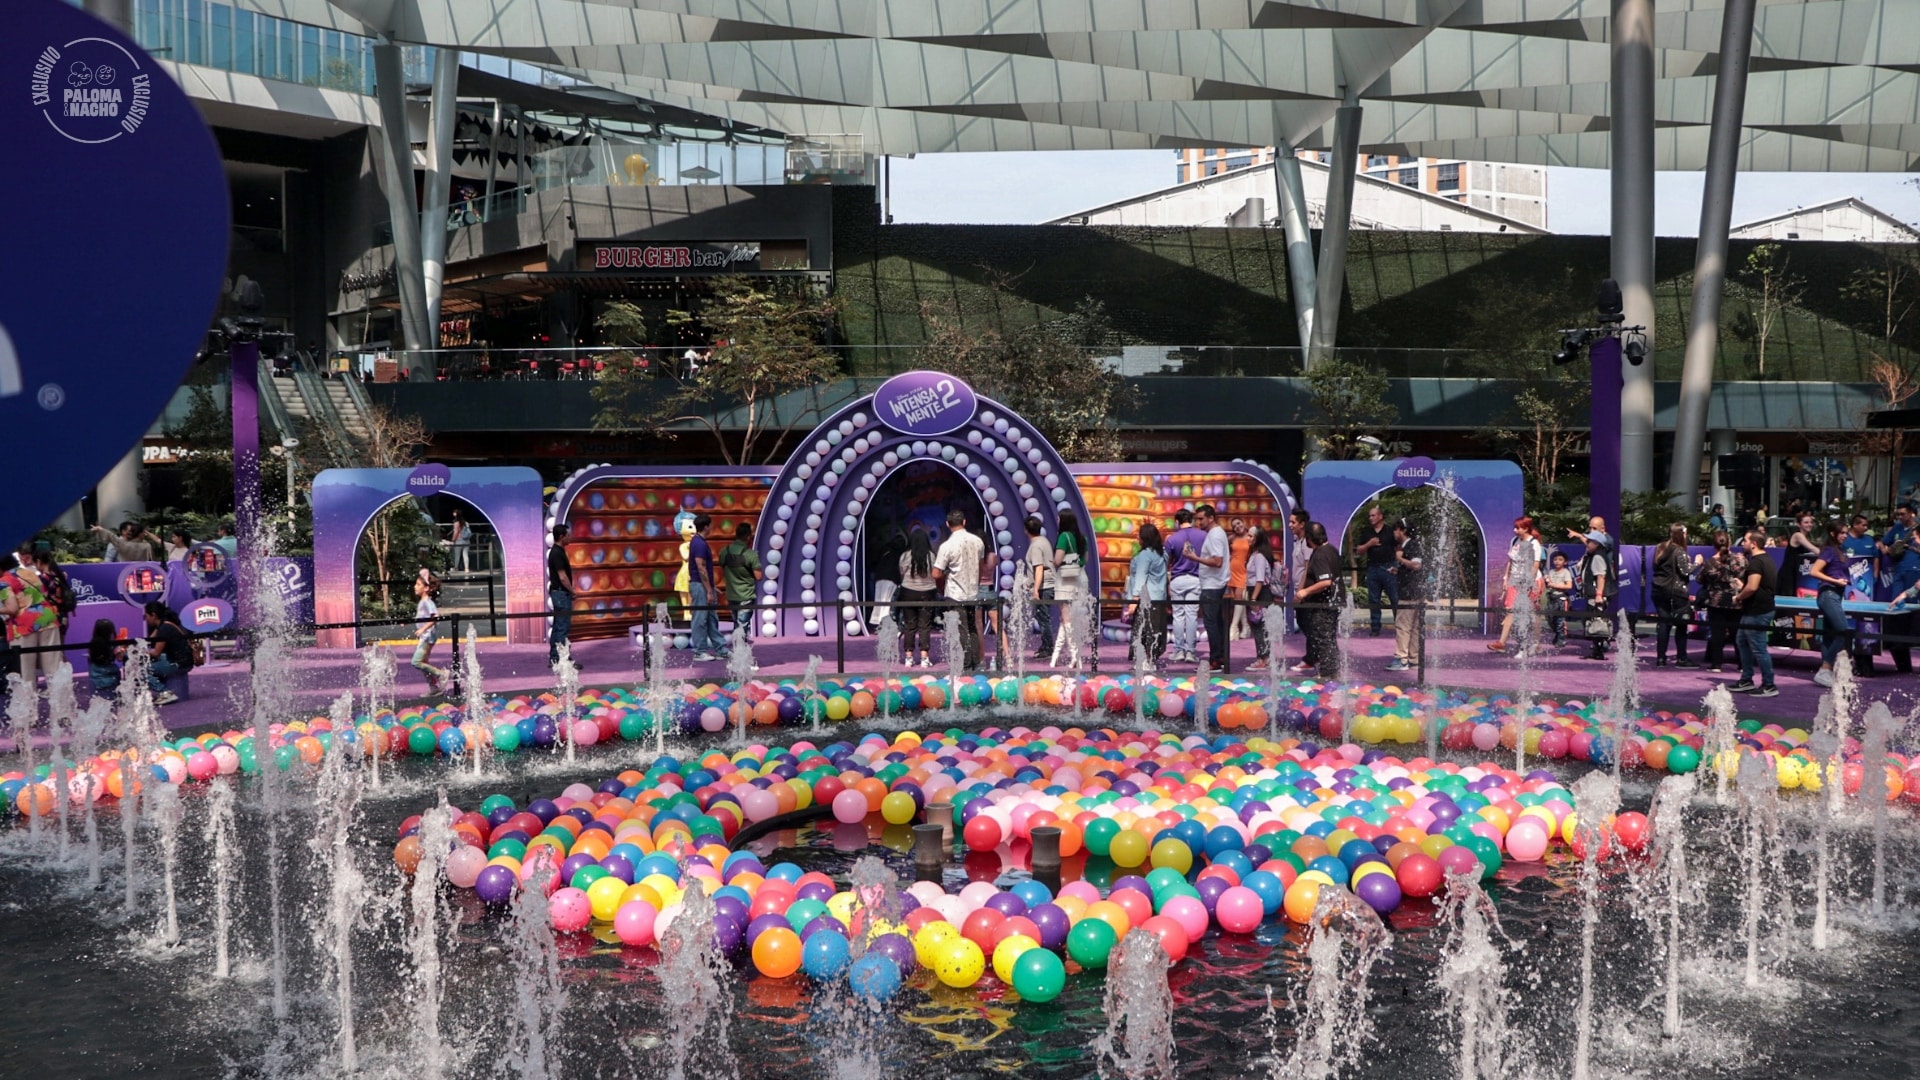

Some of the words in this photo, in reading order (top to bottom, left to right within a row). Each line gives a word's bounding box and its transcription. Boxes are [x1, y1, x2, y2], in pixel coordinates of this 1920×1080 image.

[595, 246, 692, 268] BURGER
[693, 250, 724, 266] bar
[888, 387, 939, 418] INTENSA
[936, 379, 961, 409] 2
[905, 401, 944, 428] MENTE
[1740, 441, 1764, 454] shop
[409, 475, 445, 486] salida
[1397, 467, 1431, 478] salida
[198, 609, 216, 618] Pritt
